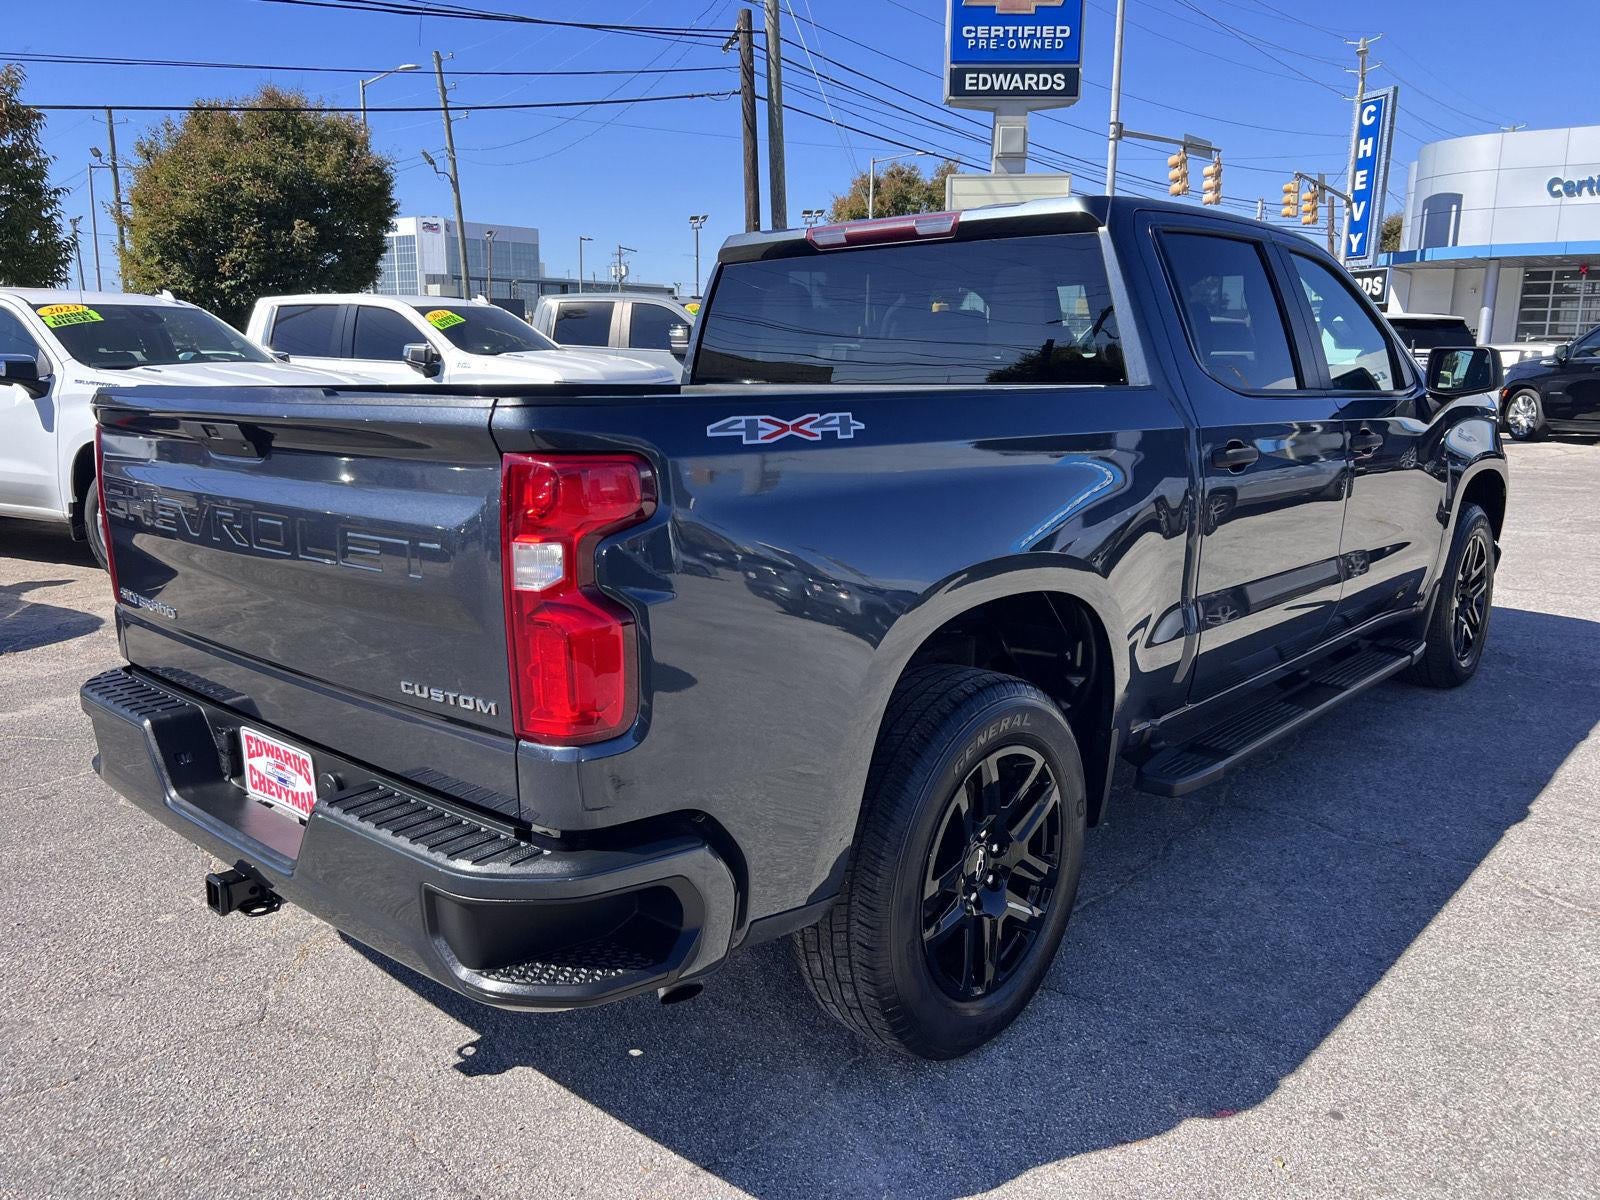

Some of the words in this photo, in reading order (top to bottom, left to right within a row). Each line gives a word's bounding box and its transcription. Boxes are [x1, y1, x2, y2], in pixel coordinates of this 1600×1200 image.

[962, 25, 1071, 38] CERTIFIED
[967, 38, 1064, 49] PRE-OWNED
[964, 73, 1066, 91] EDWARDS
[1349, 104, 1376, 253] CHEVY
[104, 479, 443, 579] CHEVROLET
[400, 680, 498, 716] CUSTOM
[245, 734, 312, 786] EDWARDS
[954, 712, 1031, 776] GENERAL
[248, 763, 315, 815] CHEVYMAN
